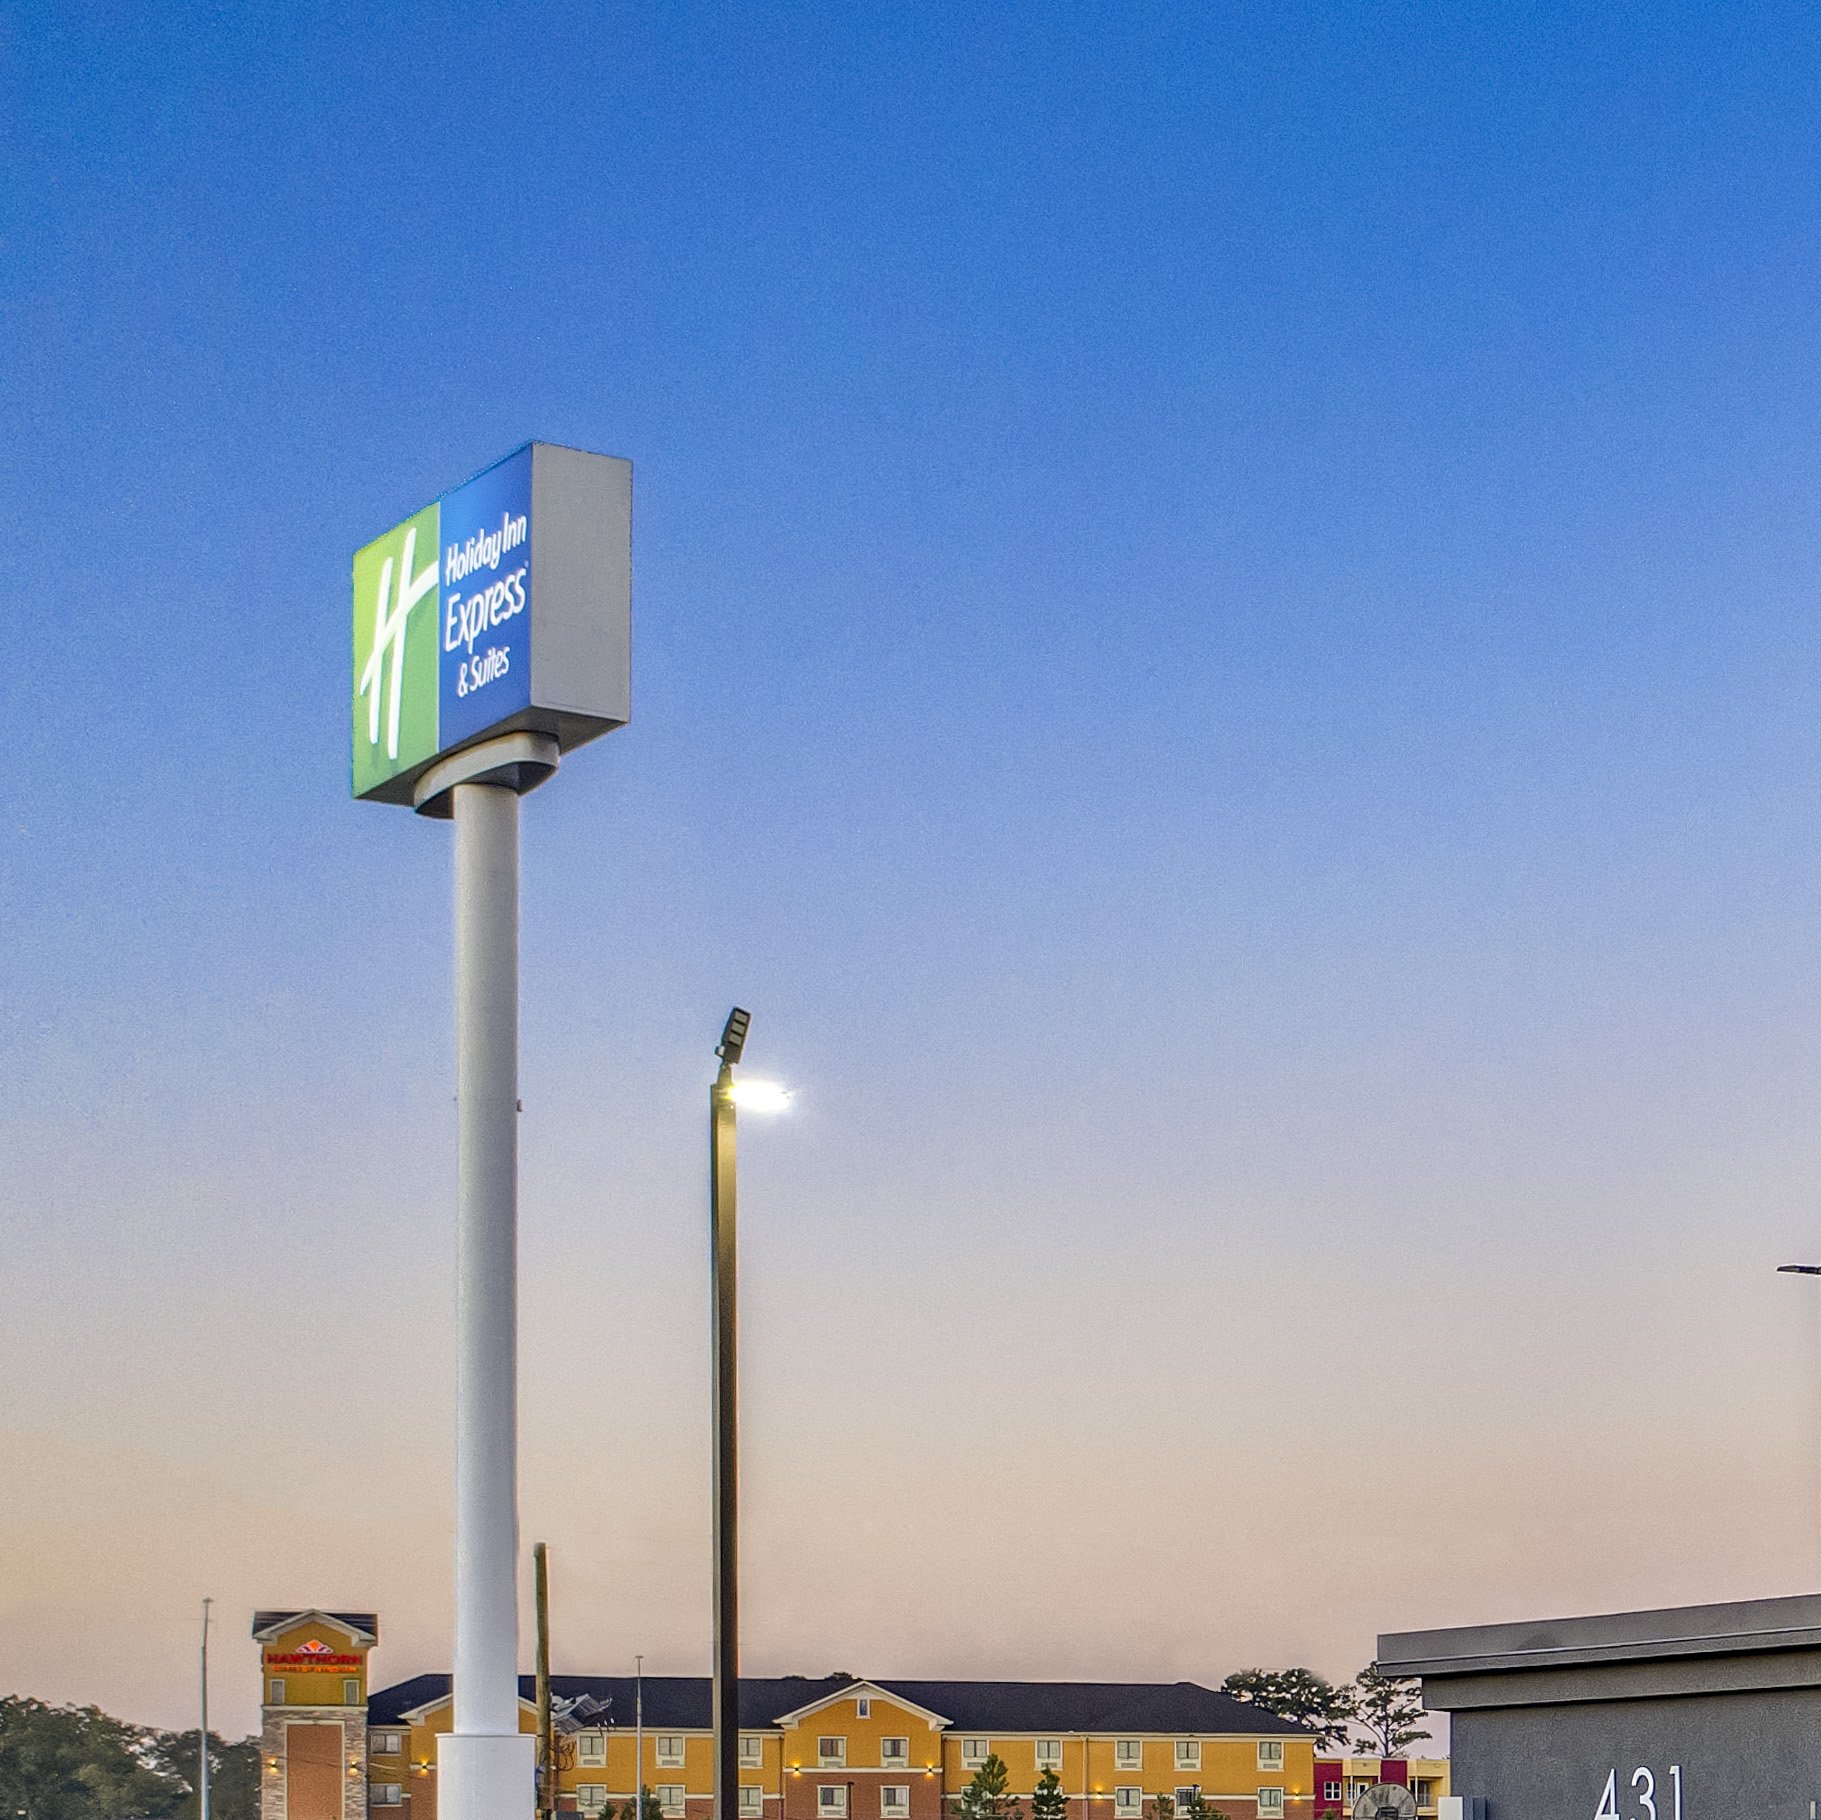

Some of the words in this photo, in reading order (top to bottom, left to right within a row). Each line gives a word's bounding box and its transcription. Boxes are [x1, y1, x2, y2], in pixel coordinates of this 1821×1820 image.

[445, 528, 502, 587] Holiday
[501, 511, 527, 554] Inn
[444, 567, 527, 655] Express
[457, 661, 469, 698] &
[469, 646, 511, 692] Suites
